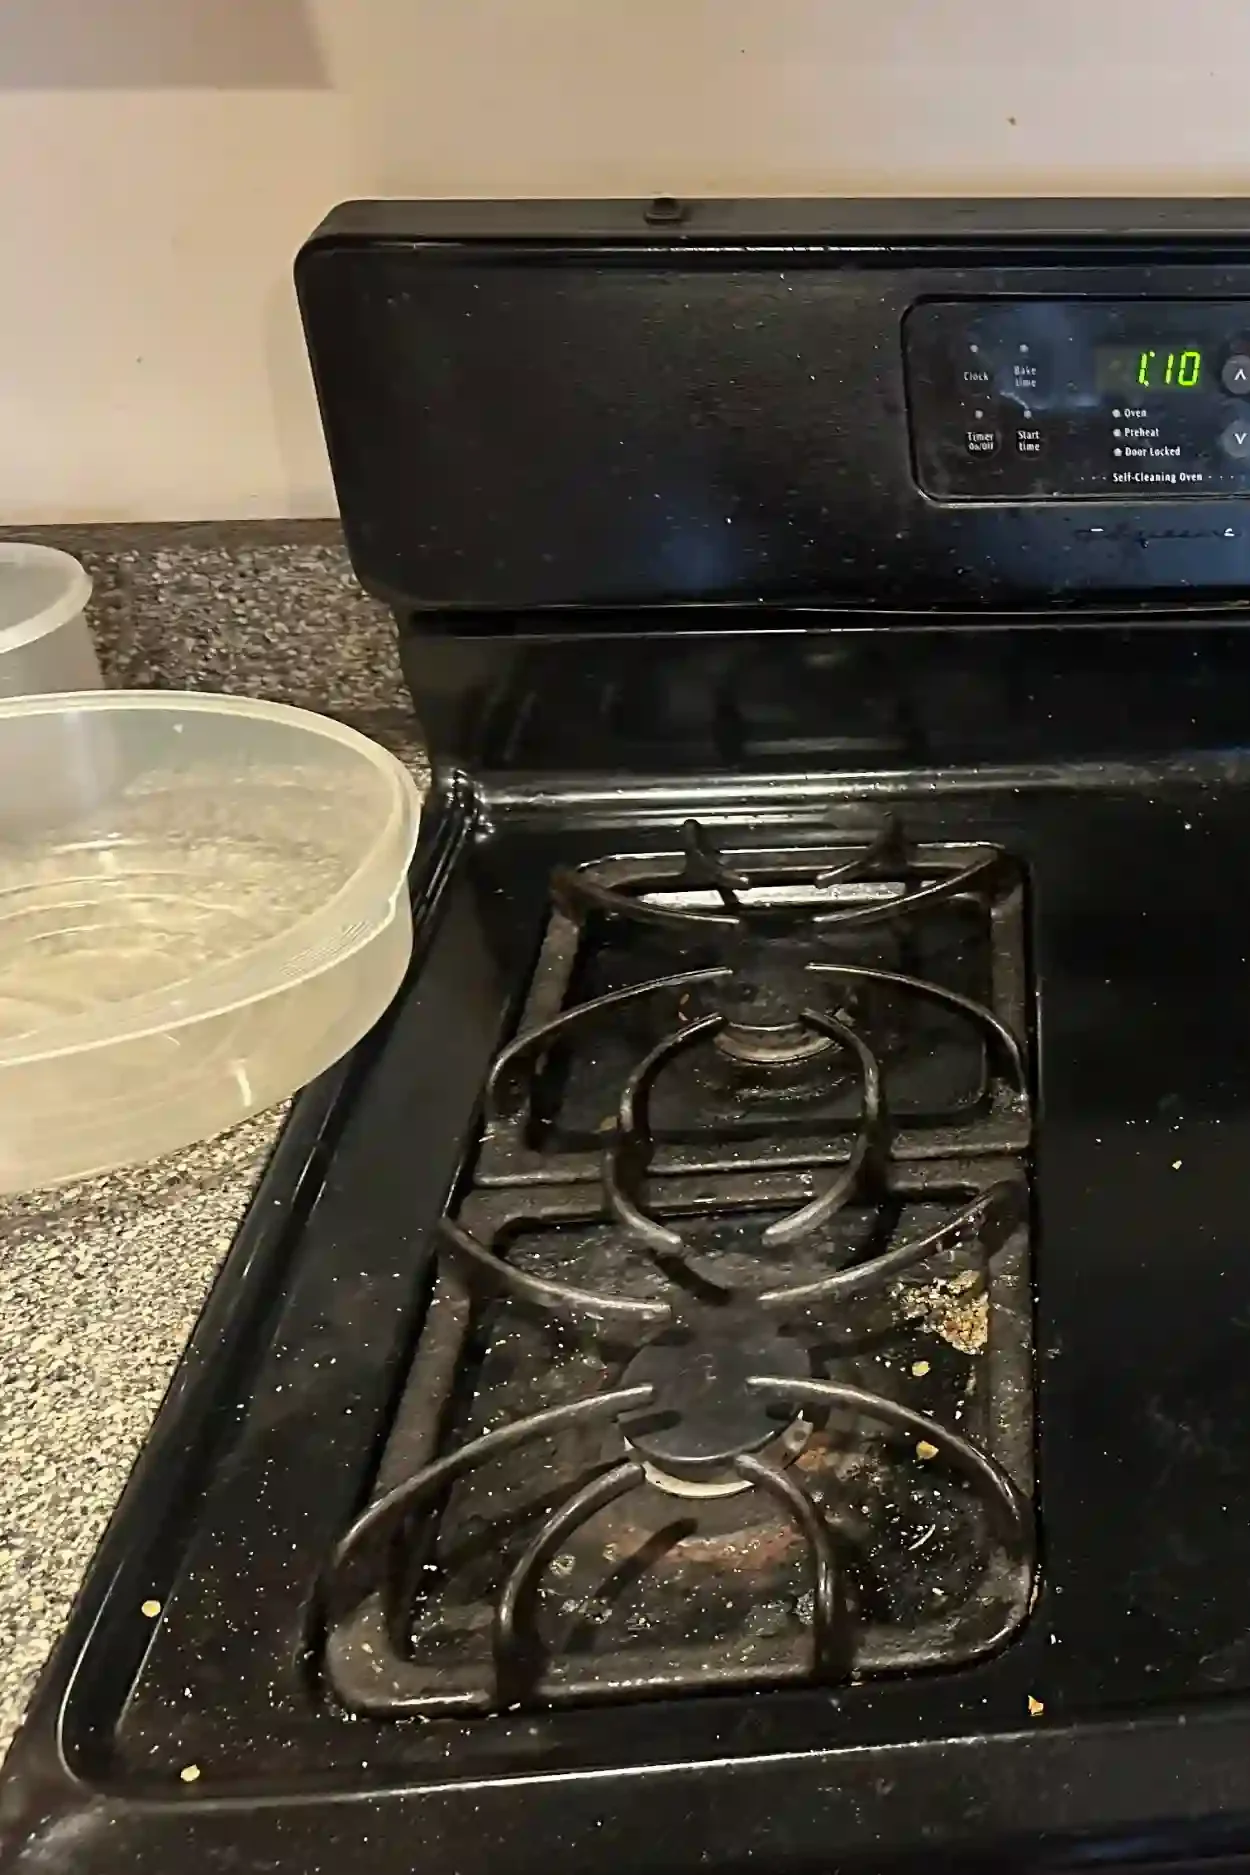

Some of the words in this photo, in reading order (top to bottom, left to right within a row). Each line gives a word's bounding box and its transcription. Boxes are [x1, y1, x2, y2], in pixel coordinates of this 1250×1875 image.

[963, 371, 989, 381] Clock
[1013, 365, 1037, 376] Bake
[1015, 377, 1037, 388] time
[1123, 408, 1148, 418] Oven
[967, 431, 994, 442] Timer
[1018, 429, 1041, 440] Start
[1123, 427, 1160, 438] Preheat
[968, 441, 994, 451] On/Off
[1018, 441, 1041, 452] time
[1124, 446, 1148, 457] Door
[1149, 445, 1181, 457] Locked
[1112, 470, 1177, 485] Self-Cleaning
[1179, 471, 1203, 482] Oven
